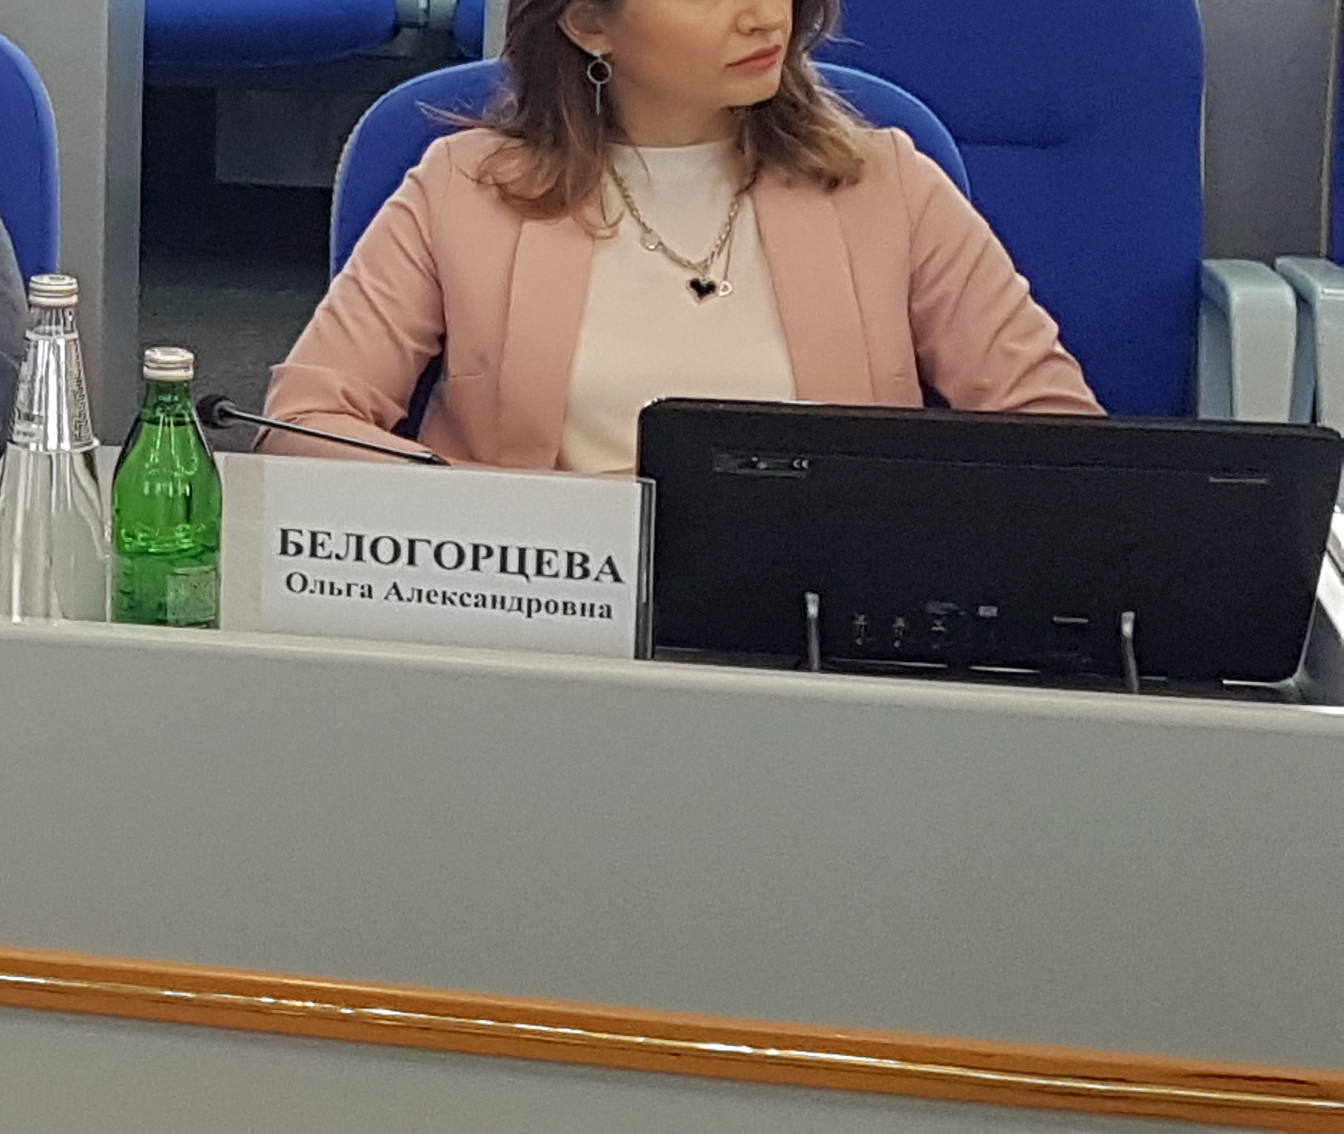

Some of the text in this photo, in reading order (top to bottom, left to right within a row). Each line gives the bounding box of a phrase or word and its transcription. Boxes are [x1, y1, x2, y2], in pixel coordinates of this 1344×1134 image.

[277, 527, 626, 584] БЕЛОГОРЦЕВА
[284, 571, 614, 620] Ольга Александровна
